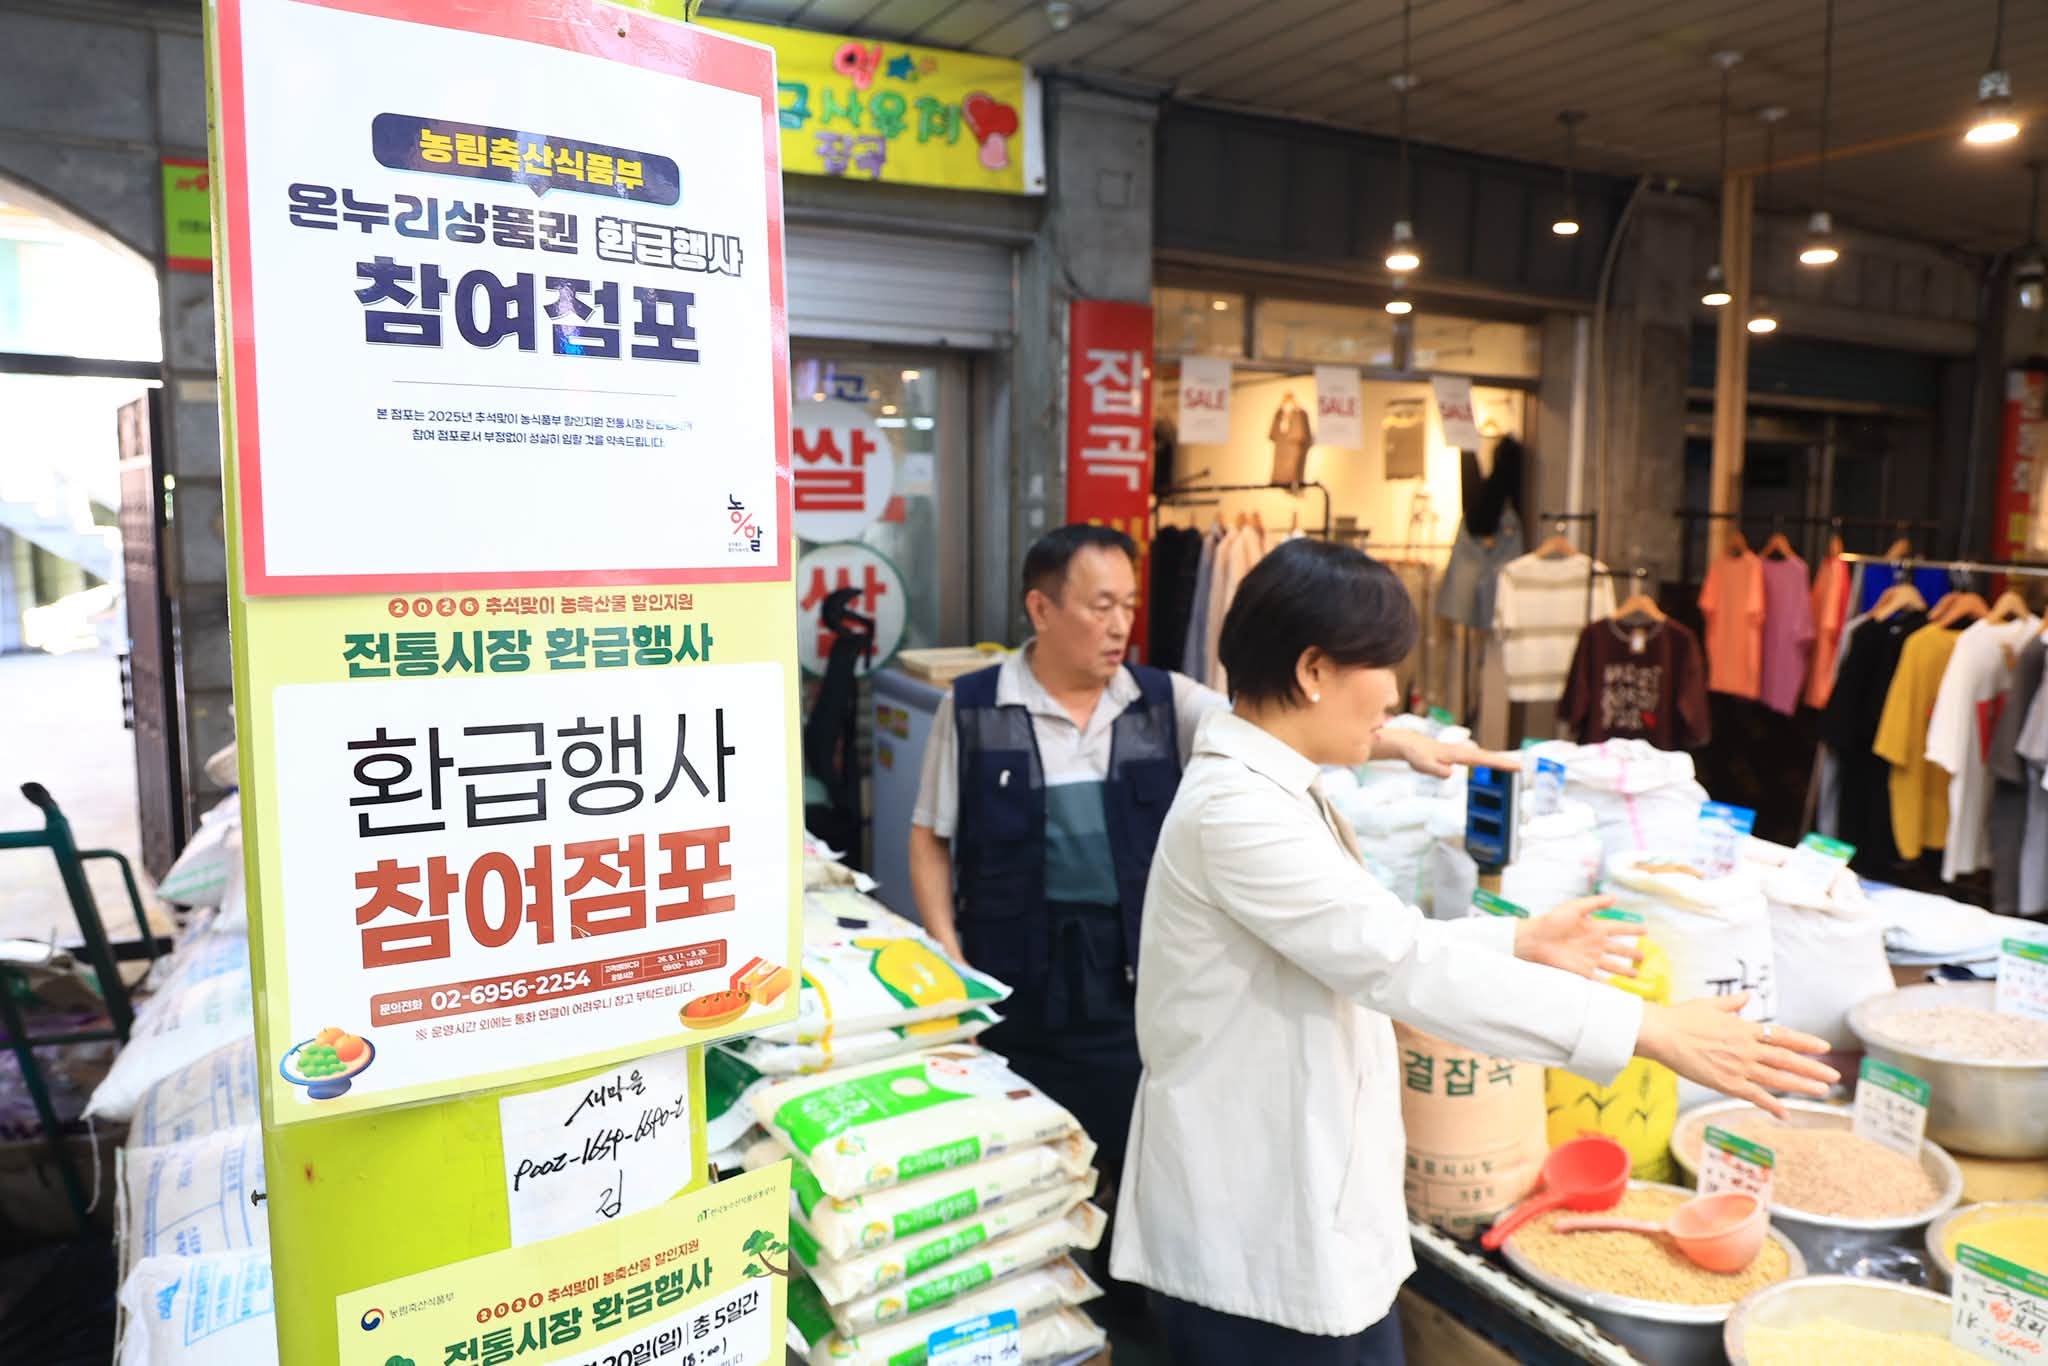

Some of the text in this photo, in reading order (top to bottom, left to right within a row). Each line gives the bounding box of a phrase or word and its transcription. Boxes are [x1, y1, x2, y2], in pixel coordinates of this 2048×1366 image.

[419, 128, 645, 190] 농림축산식품부
[288, 183, 744, 278] 온누리상품권 환급행사
[354, 255, 700, 364] 참여점포
[376, 408, 388, 420] 본
[391, 408, 425, 421] 점포는
[428, 410, 473, 423] 2025년
[475, 411, 518, 424] 추석맞이
[521, 413, 561, 426] 농식품부
[563, 415, 604, 428] 할인지원
[606, 417, 644, 430] 전통시장
[1081, 349, 1148, 491] 잡곡
[1183, 387, 1226, 411] SALE
[1317, 395, 1356, 417] SALE
[412, 428, 665, 448] 참여 점포로서 부정없이 성실히 임할 것을 약속드립니다.
[793, 427, 877, 513] 쌀
[388, 592, 694, 618] 2026 추석맞이 농축산물 할인지원
[343, 622, 714, 678] 전통시장 환급행사
[347, 708, 736, 838] 환급행사
[355, 825, 736, 969] 참여점포
[430, 969, 592, 1011] 02-6956-2254
[431, 1022, 476, 1038] 운영시간
[479, 1016, 512, 1030] 외에는
[515, 1011, 536, 1026] 통화
[538, 1006, 570, 1020] 연결이
[572, 999, 612, 1015] 어려우니
[615, 993, 635, 1007] 참고
[636, 982, 696, 1002] 부탁드립니다.
[595, 1169, 623, 1218] 김
[547, 1275, 599, 1303] 추석맞이
[602, 1257, 651, 1287] 농축산물
[654, 1238, 700, 1267] 할인지원
[444, 1257, 713, 1366] 전통시장 환급행사
[693, 1313, 711, 1339] 총
[714, 1290, 760, 1329] 5일간
